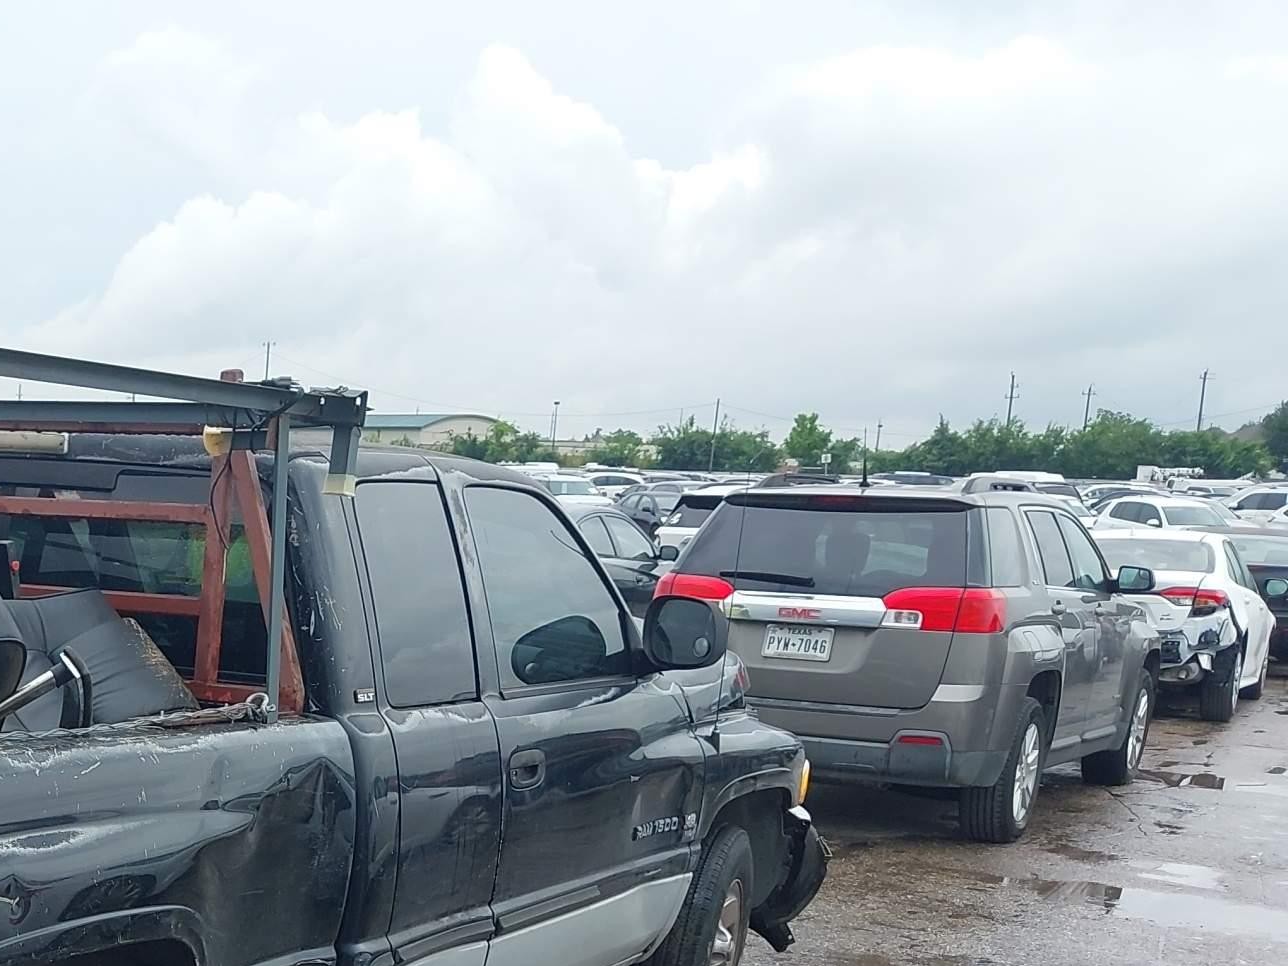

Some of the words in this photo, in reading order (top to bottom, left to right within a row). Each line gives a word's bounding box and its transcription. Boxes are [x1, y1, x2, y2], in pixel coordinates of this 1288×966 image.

[778, 607, 822, 619] GMC
[787, 627, 813, 636] TEXAS
[357, 692, 375, 702] SLT
[653, 816, 679, 834] 1500
